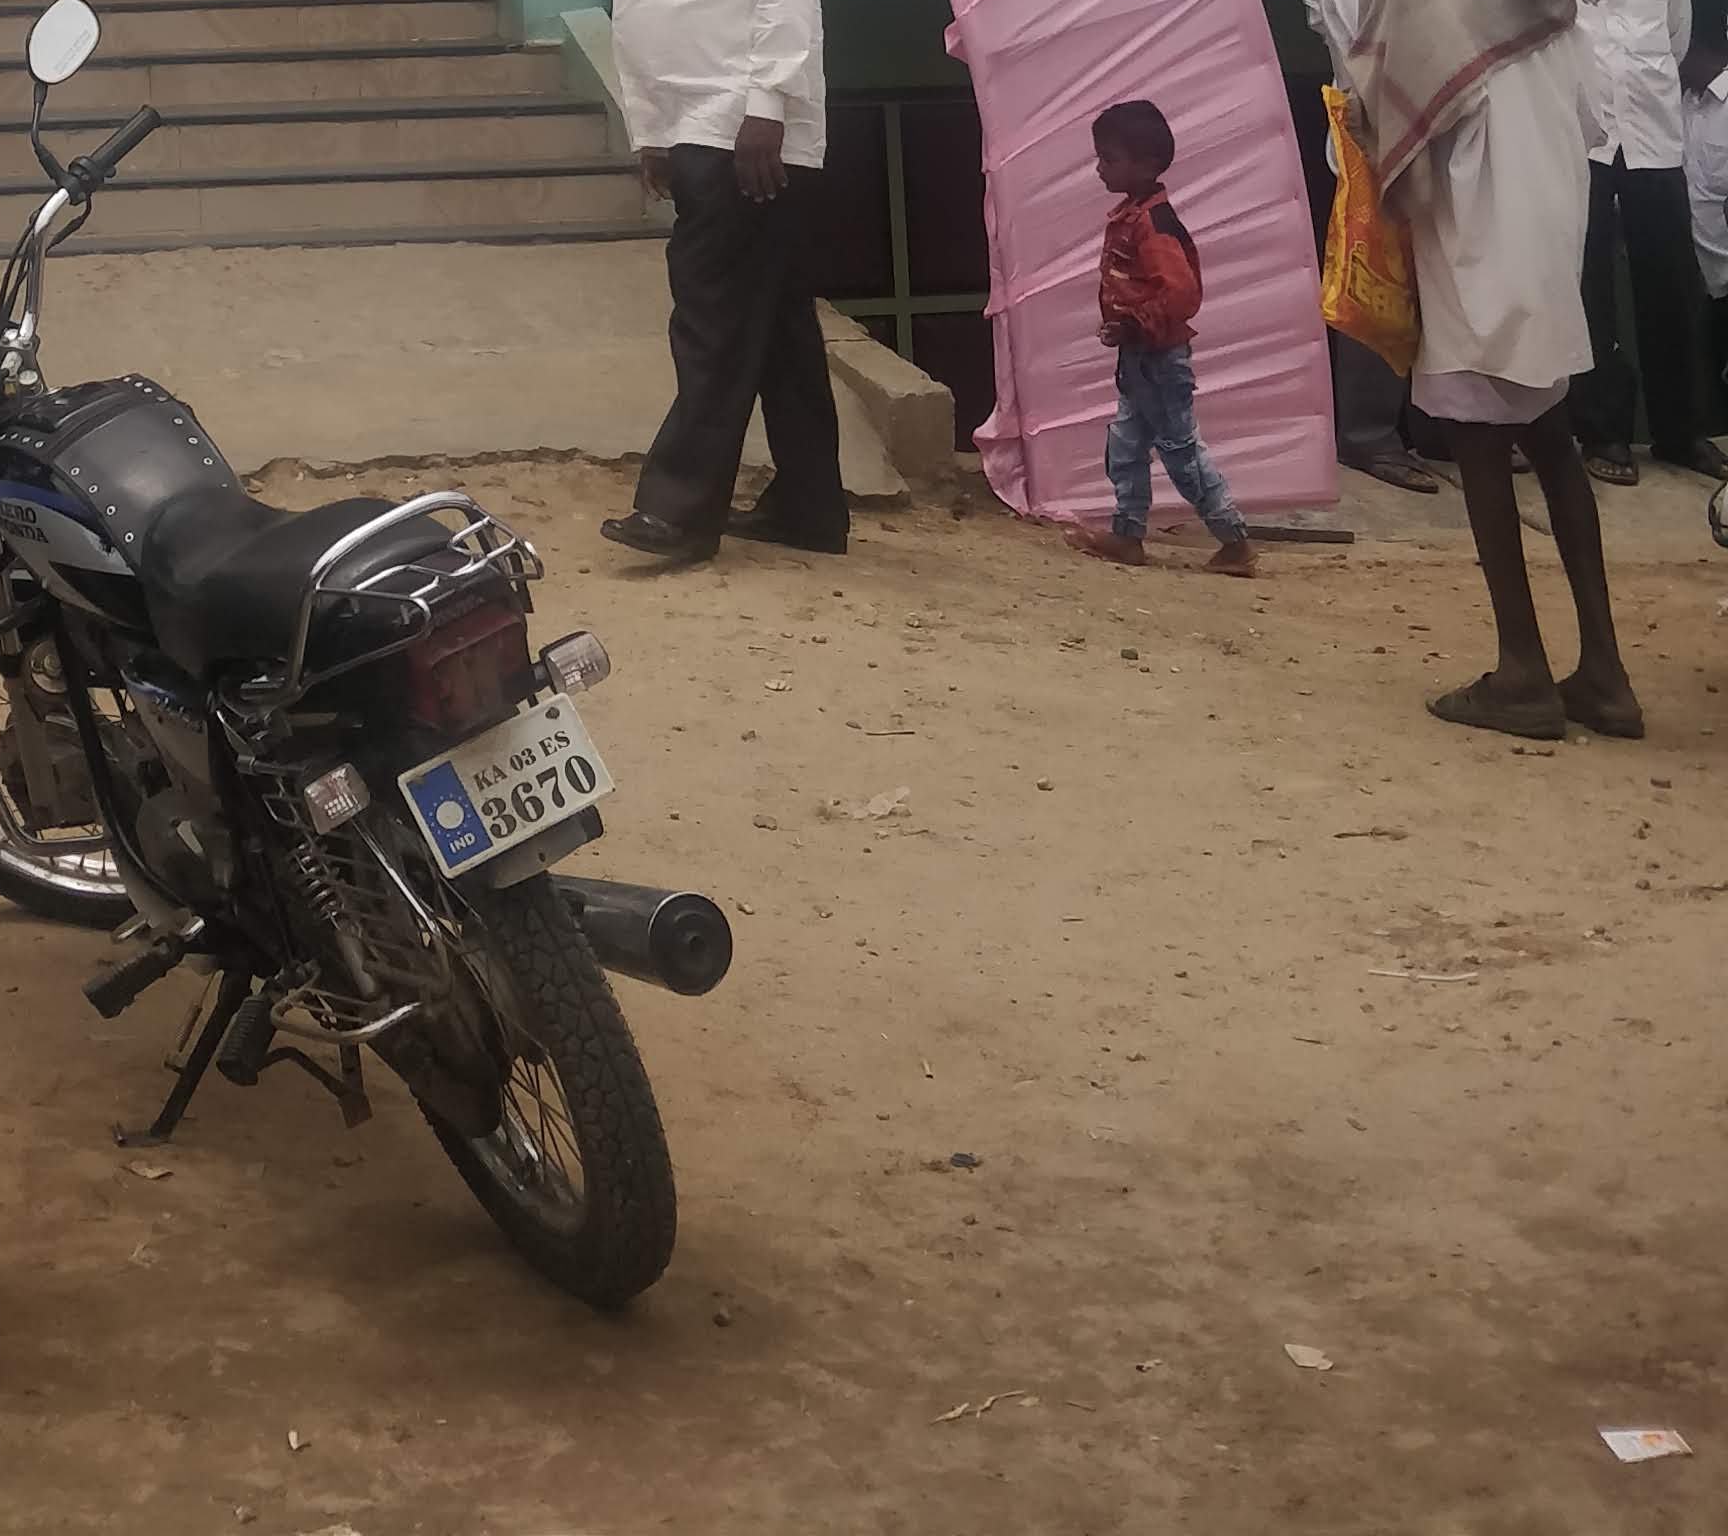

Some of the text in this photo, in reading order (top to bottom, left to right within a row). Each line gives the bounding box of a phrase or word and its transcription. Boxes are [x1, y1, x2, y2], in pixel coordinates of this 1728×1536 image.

[473, 730, 571, 792] KA 03 ES
[481, 755, 597, 839] 3670
[449, 832, 476, 854] IND
